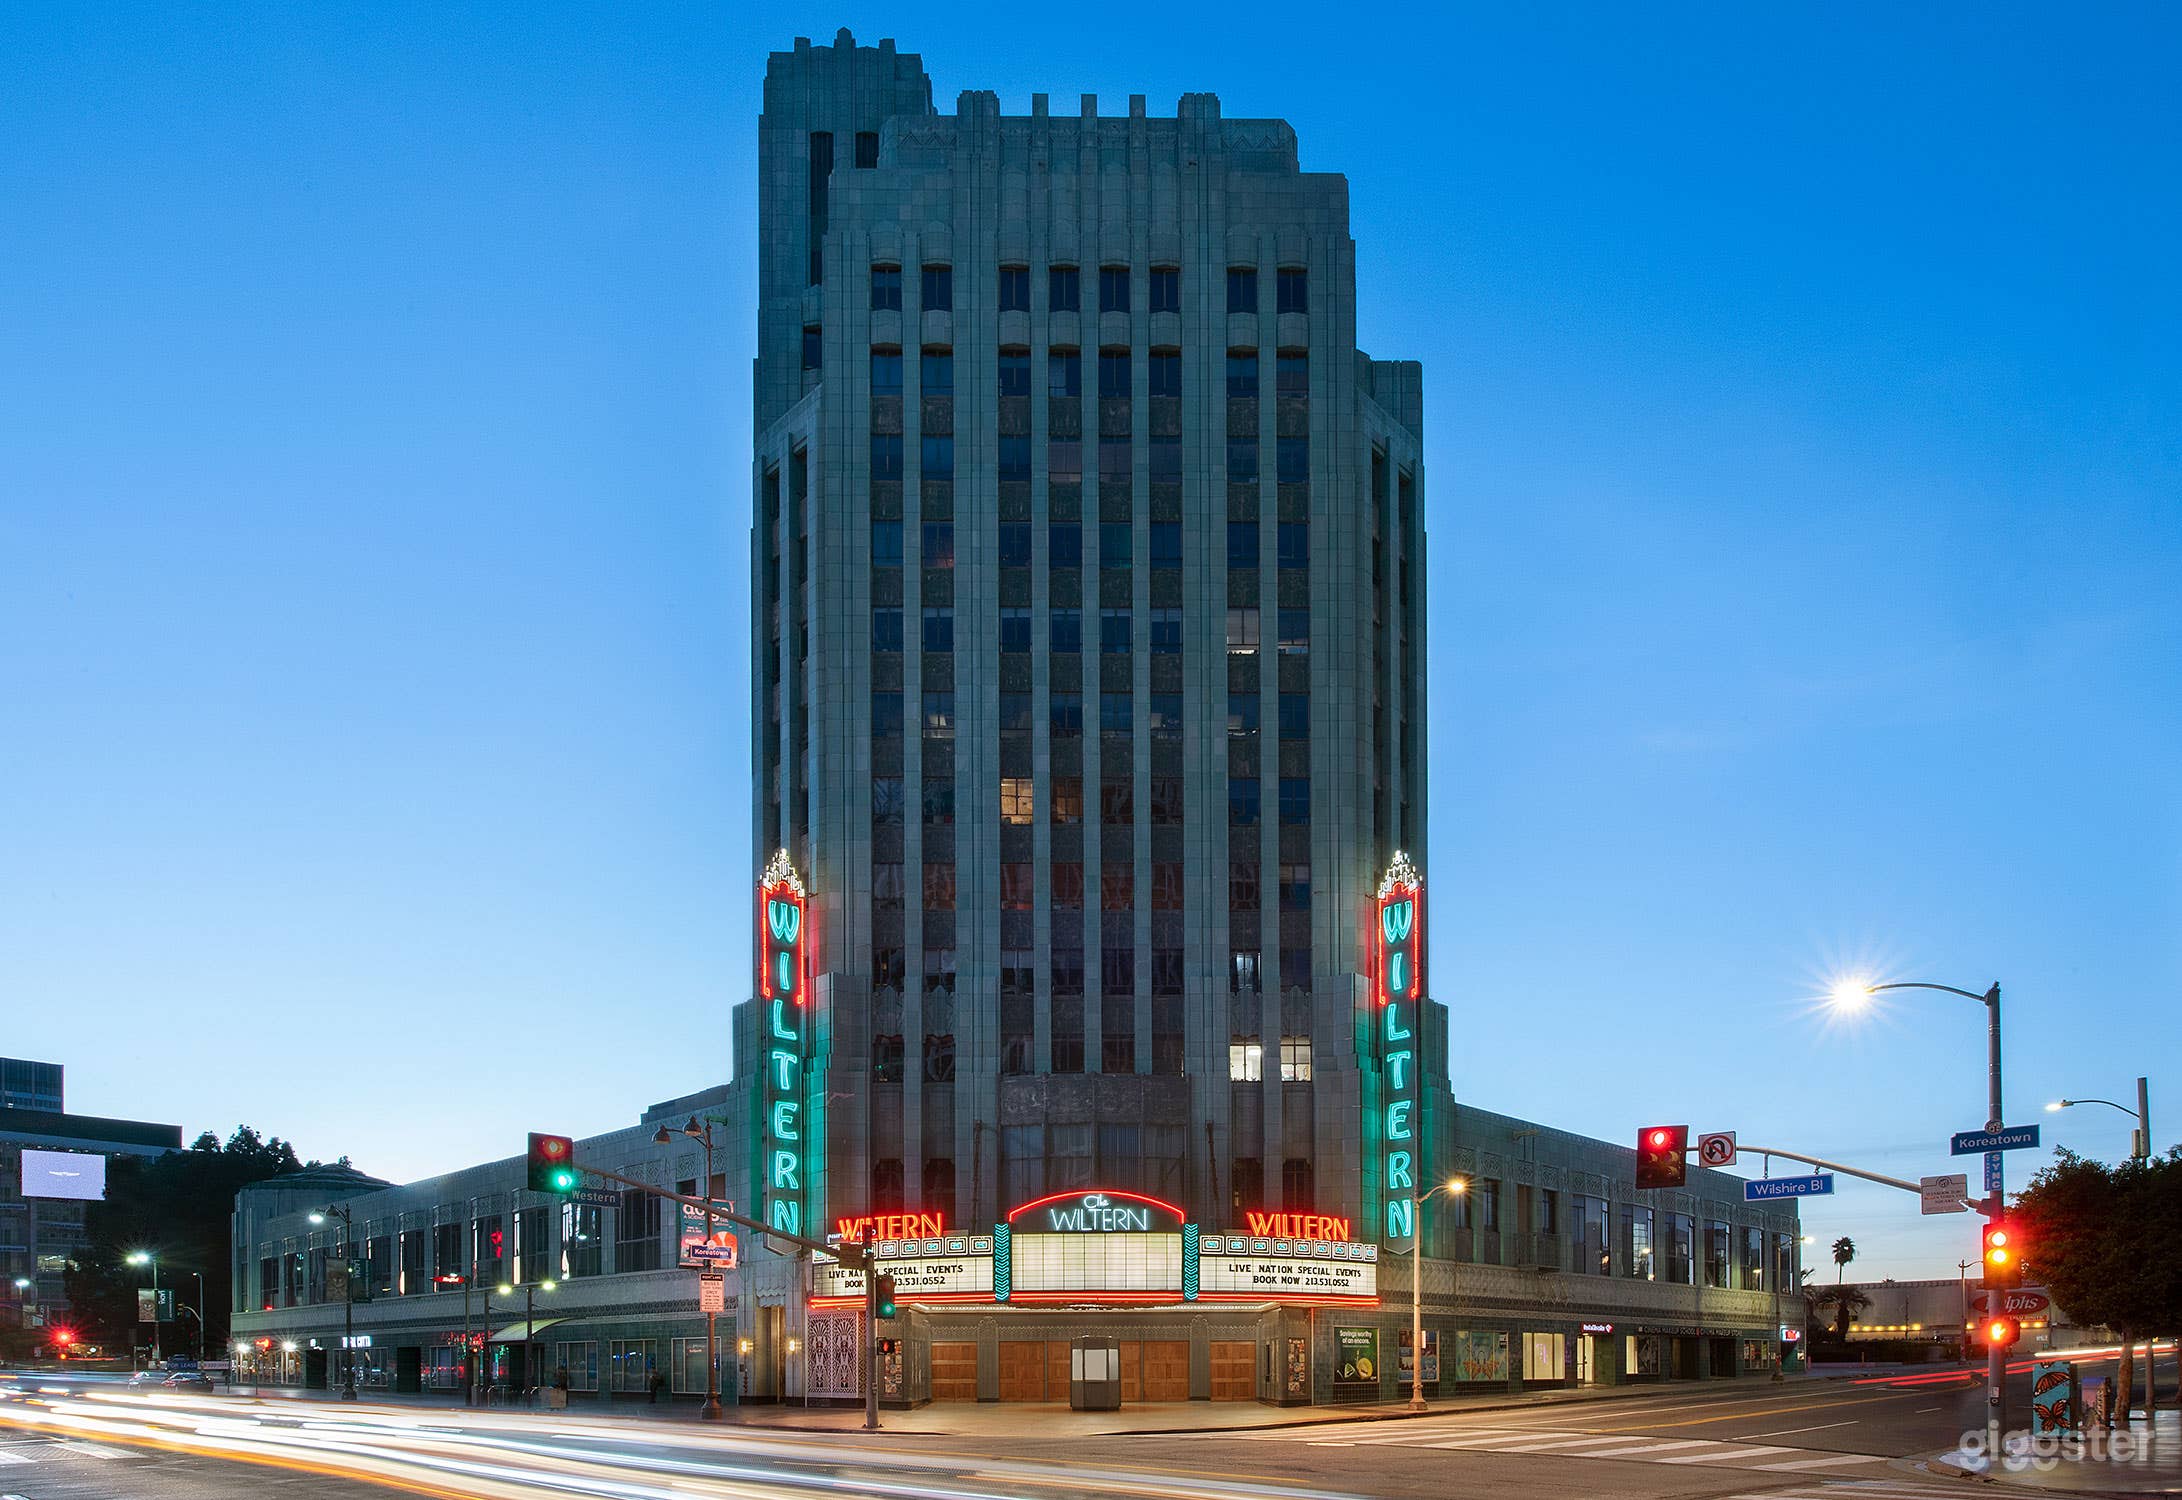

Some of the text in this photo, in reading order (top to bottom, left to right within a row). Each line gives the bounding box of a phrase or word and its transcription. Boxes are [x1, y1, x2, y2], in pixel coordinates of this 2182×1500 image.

[768, 900, 800, 1236] WILTERN
[1382, 900, 1413, 1238] WILTERN
[1960, 1134, 2031, 1149] Koreatown
[1755, 1180, 1823, 1195] Wilshire Bl
[571, 1190, 616, 1203] Western
[1084, 1193, 1109, 1209] The
[1050, 1208, 1147, 1231] WILTERN
[1247, 1212, 1349, 1242] WILTERN
[694, 1248, 729, 1257] Koreatown
[828, 1270, 845, 1279] LIVE
[883, 1266, 919, 1276] SPECIAL
[926, 1264, 964, 1274] EVENTS
[1229, 1263, 1362, 1277] LIVE NATION SPECIAL EVENTS
[845, 1276, 946, 1288] BOOK 13.531.0552
[1253, 1275, 1350, 1287] BOOK NOW 213.531.0552
[1985, 1295, 2039, 1313] lphs
[1339, 1329, 1373, 1339] Savings worthy
